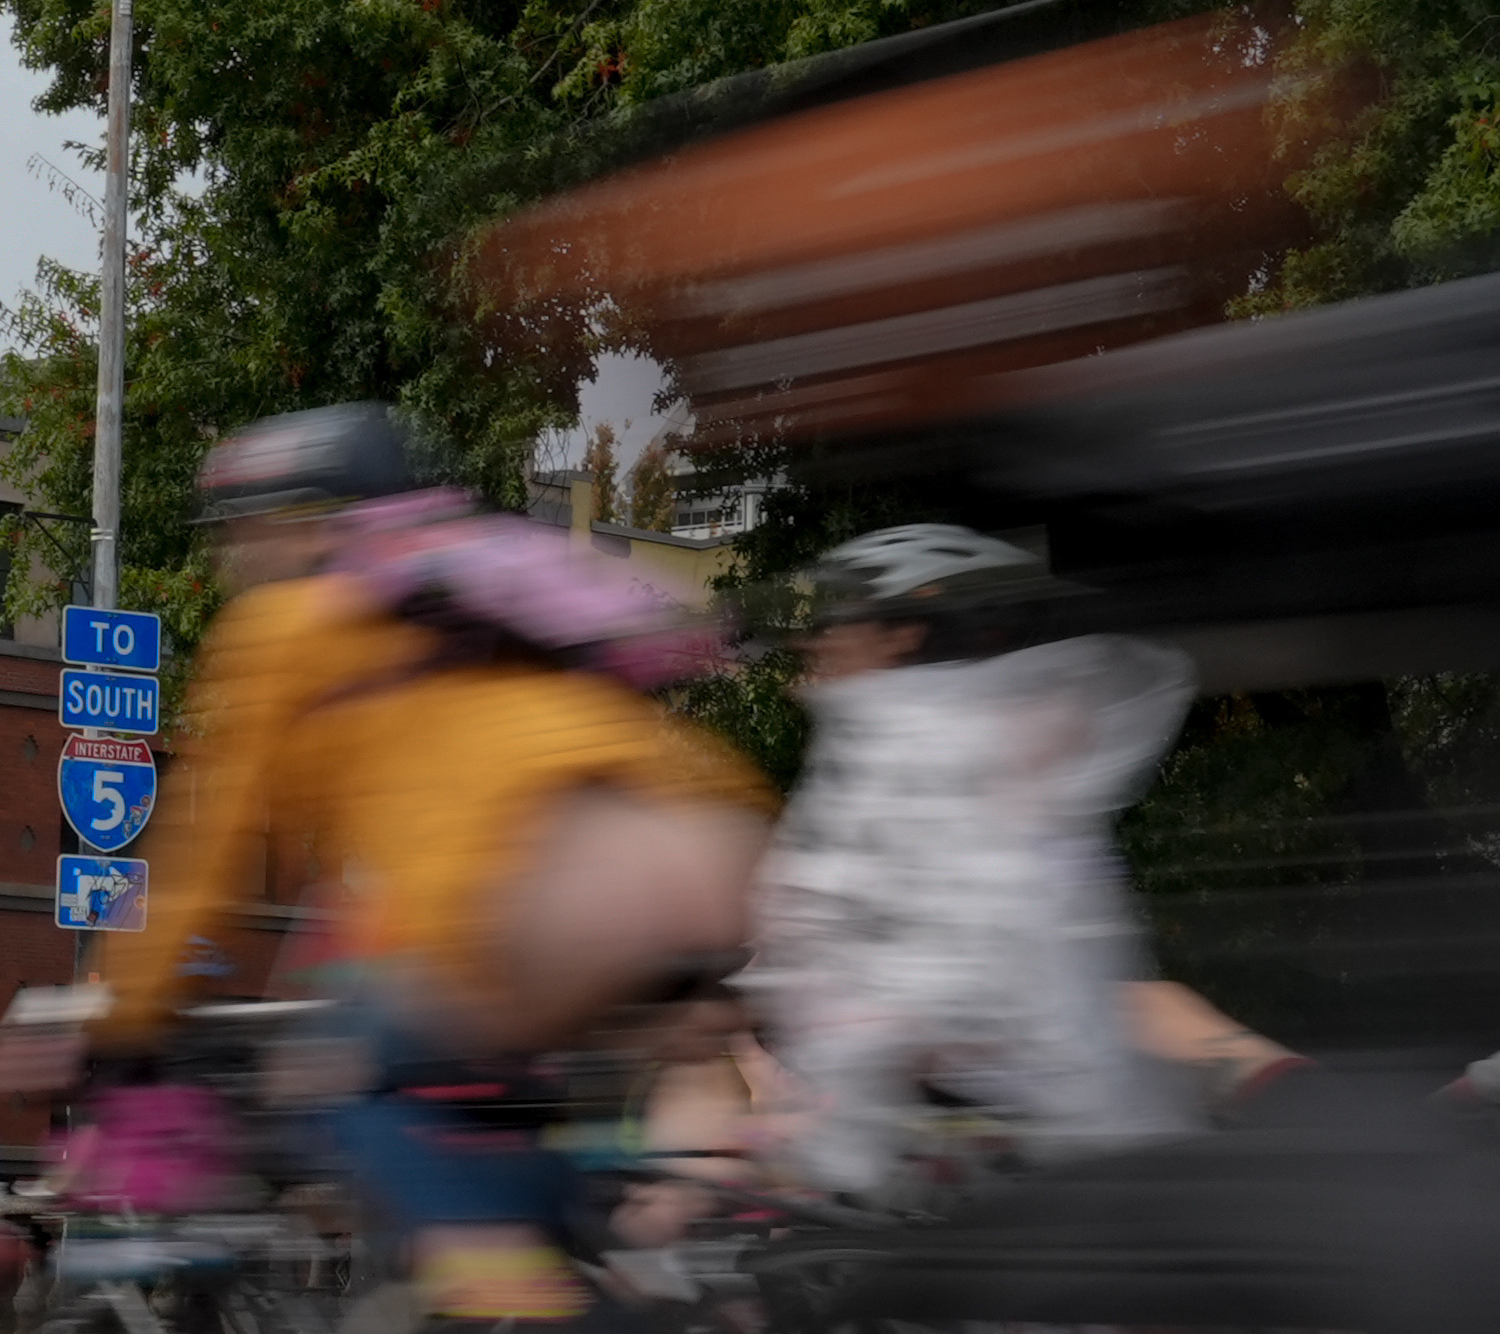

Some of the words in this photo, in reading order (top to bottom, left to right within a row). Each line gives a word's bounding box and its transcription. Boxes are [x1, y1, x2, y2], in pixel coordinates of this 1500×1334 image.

[89, 620, 135, 656] TO
[66, 679, 153, 720] SOUTH
[75, 742, 143, 761] INTERSTATE
[89, 769, 126, 832] 5
